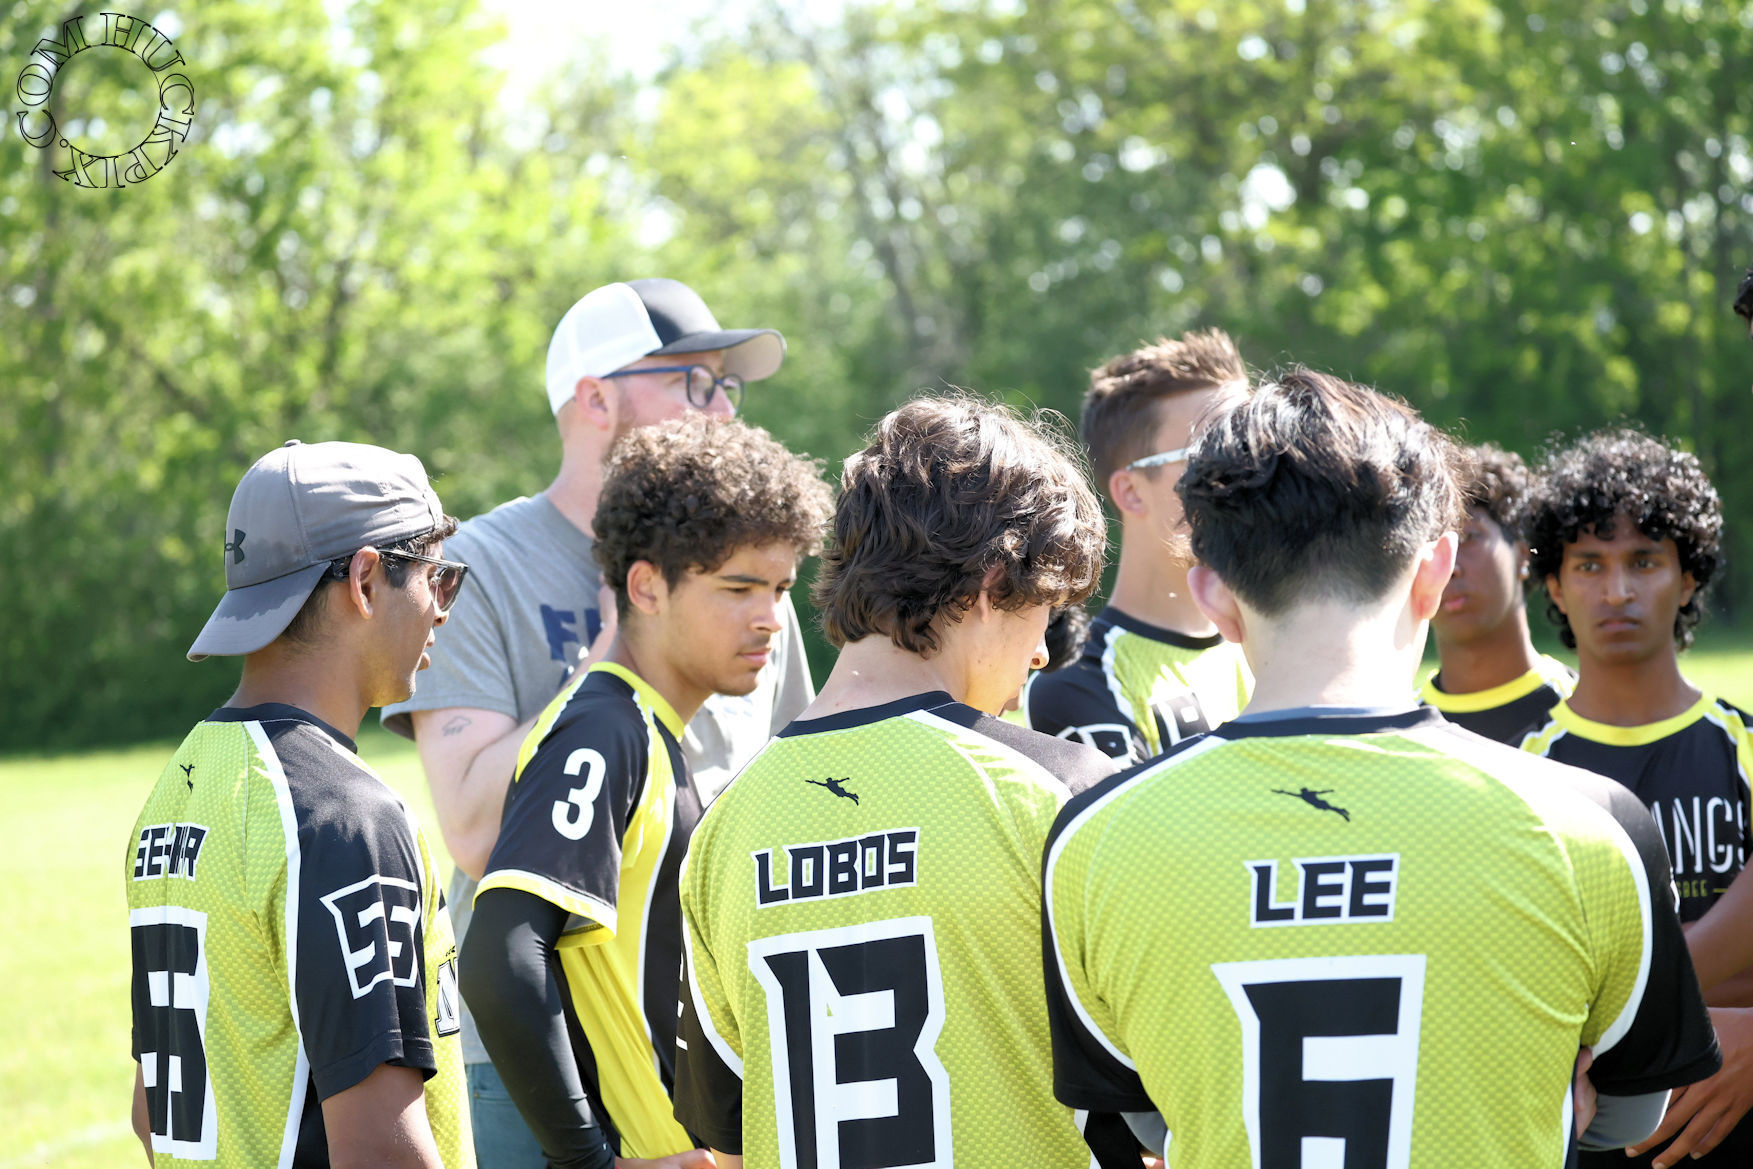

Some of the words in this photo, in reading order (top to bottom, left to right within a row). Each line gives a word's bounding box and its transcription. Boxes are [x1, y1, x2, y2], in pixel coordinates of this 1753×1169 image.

[552, 747, 606, 840] 3
[750, 826, 920, 909] LOBOS
[1243, 853, 1400, 928] LEE
[746, 916, 952, 1169] 13
[1210, 954, 1426, 1169] 6
